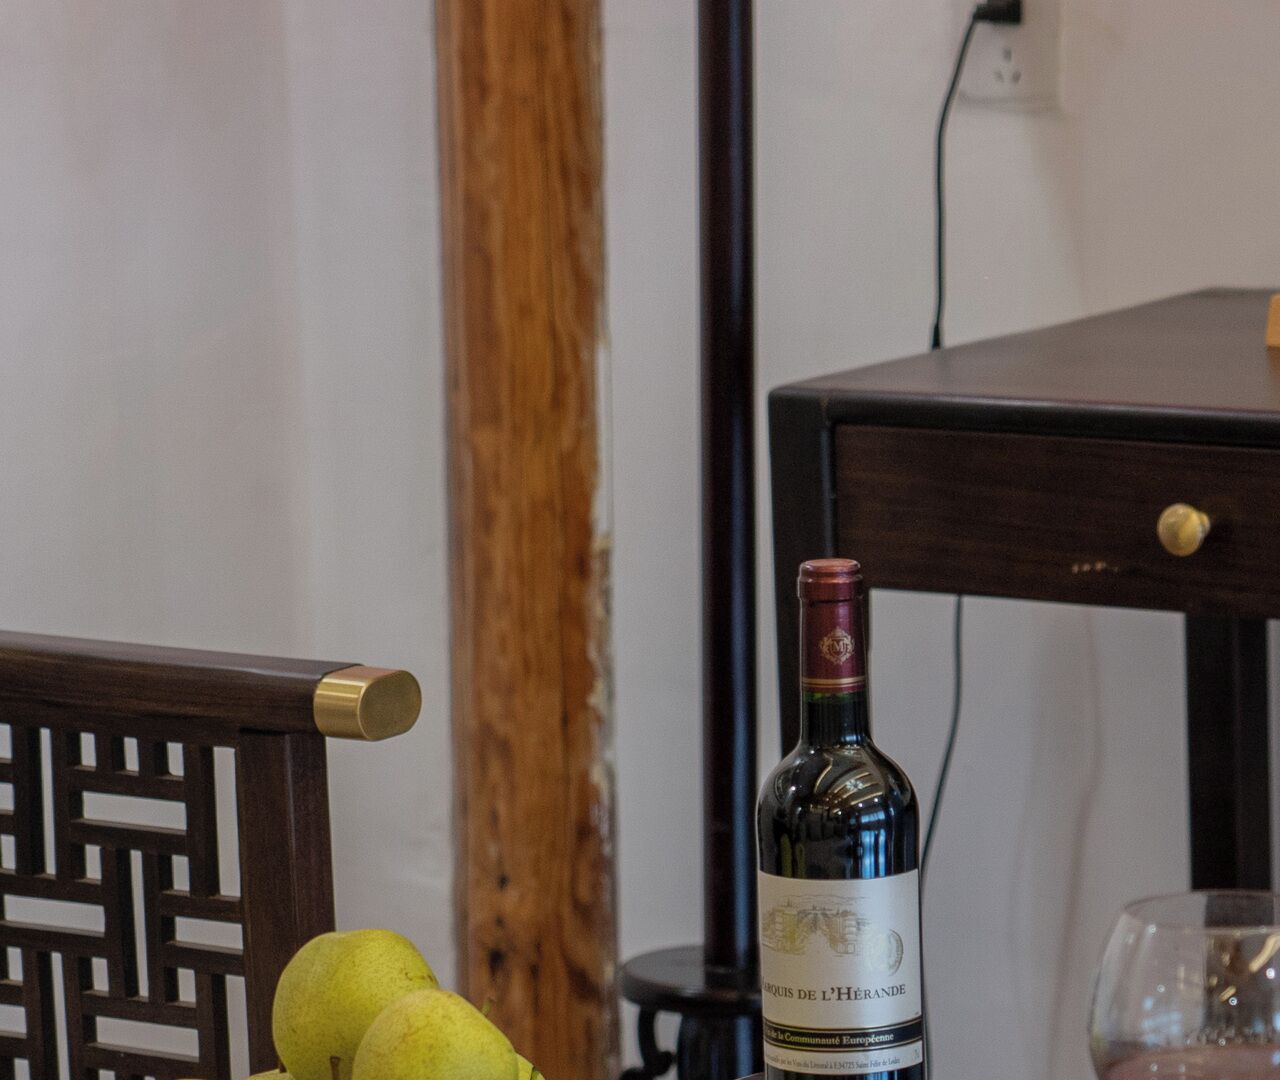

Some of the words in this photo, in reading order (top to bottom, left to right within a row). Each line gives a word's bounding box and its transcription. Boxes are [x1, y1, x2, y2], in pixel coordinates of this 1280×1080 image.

[798, 989, 817, 1001] DE
[778, 1031, 784, 1040] la
[784, 1033, 840, 1045] Communauté
[842, 1033, 894, 1046] Européenne
